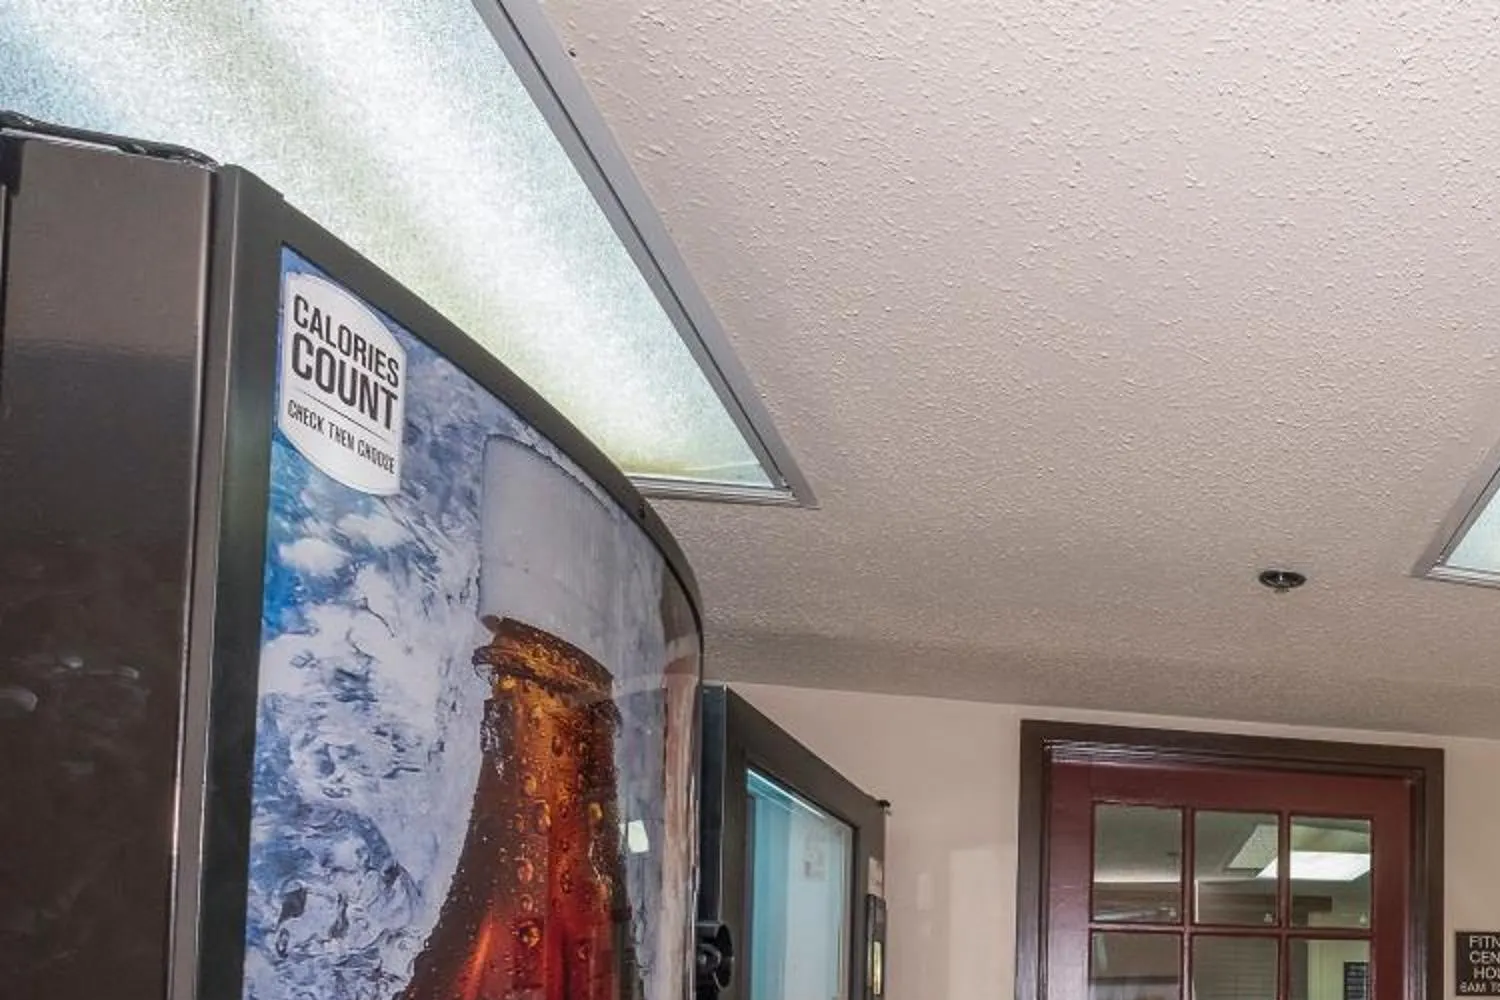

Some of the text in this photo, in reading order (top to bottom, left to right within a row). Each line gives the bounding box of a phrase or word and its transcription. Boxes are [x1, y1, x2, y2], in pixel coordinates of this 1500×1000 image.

[292, 332, 398, 430] COUNT
[293, 295, 399, 388] CALORIES
[287, 399, 395, 475] CHECK THEN CHOOSE
